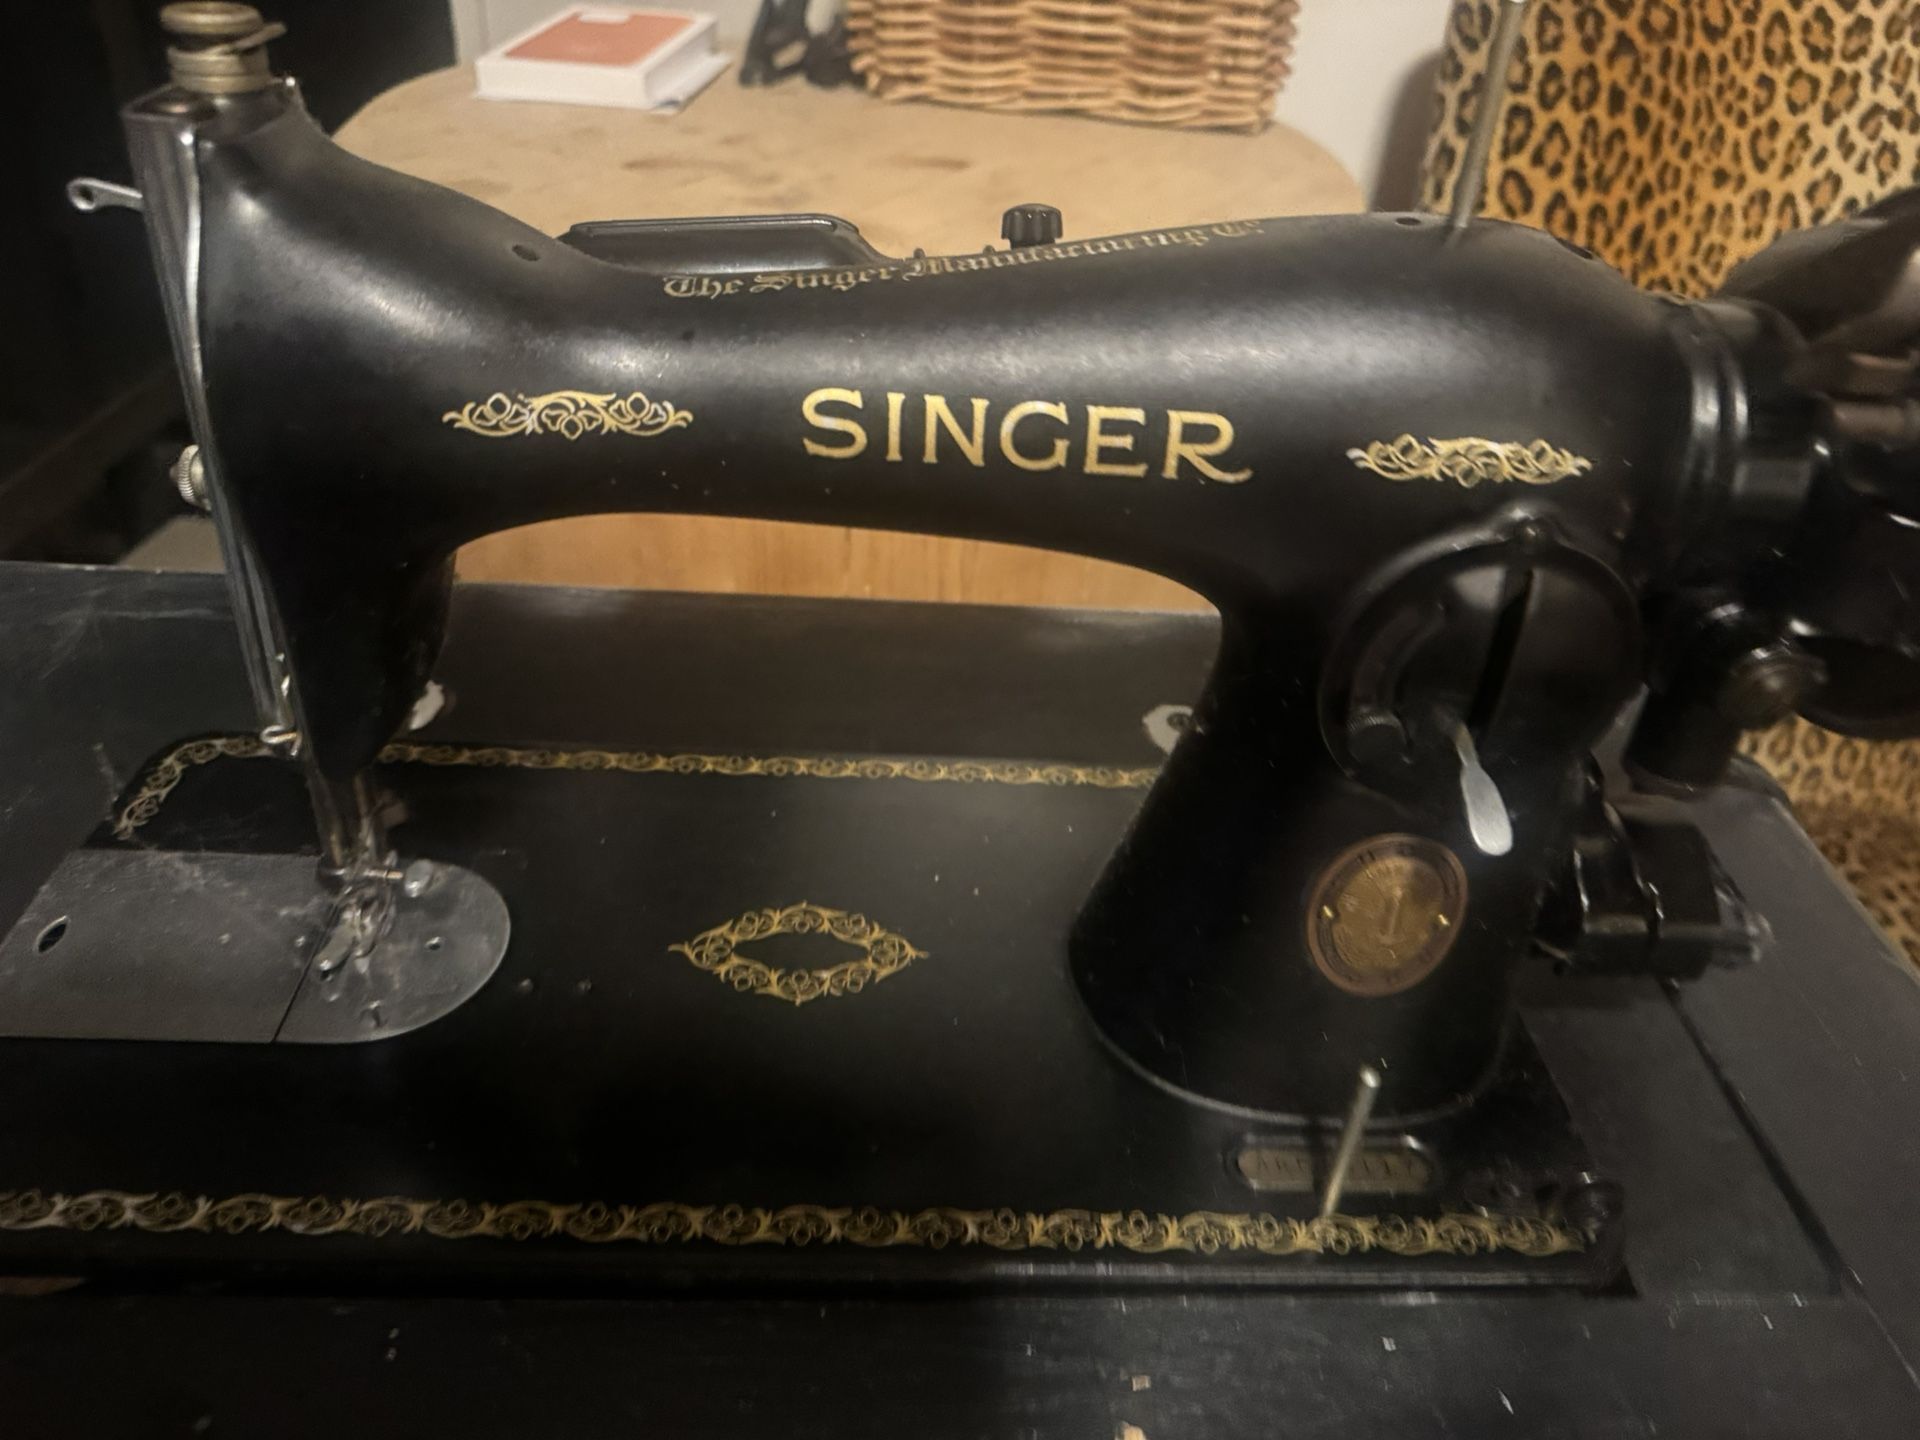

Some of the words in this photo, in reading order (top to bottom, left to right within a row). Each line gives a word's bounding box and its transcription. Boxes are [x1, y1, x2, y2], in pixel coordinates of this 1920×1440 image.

[663, 274, 744, 299] The
[750, 267, 898, 293] Singer
[802, 387, 1253, 484] SINGER
